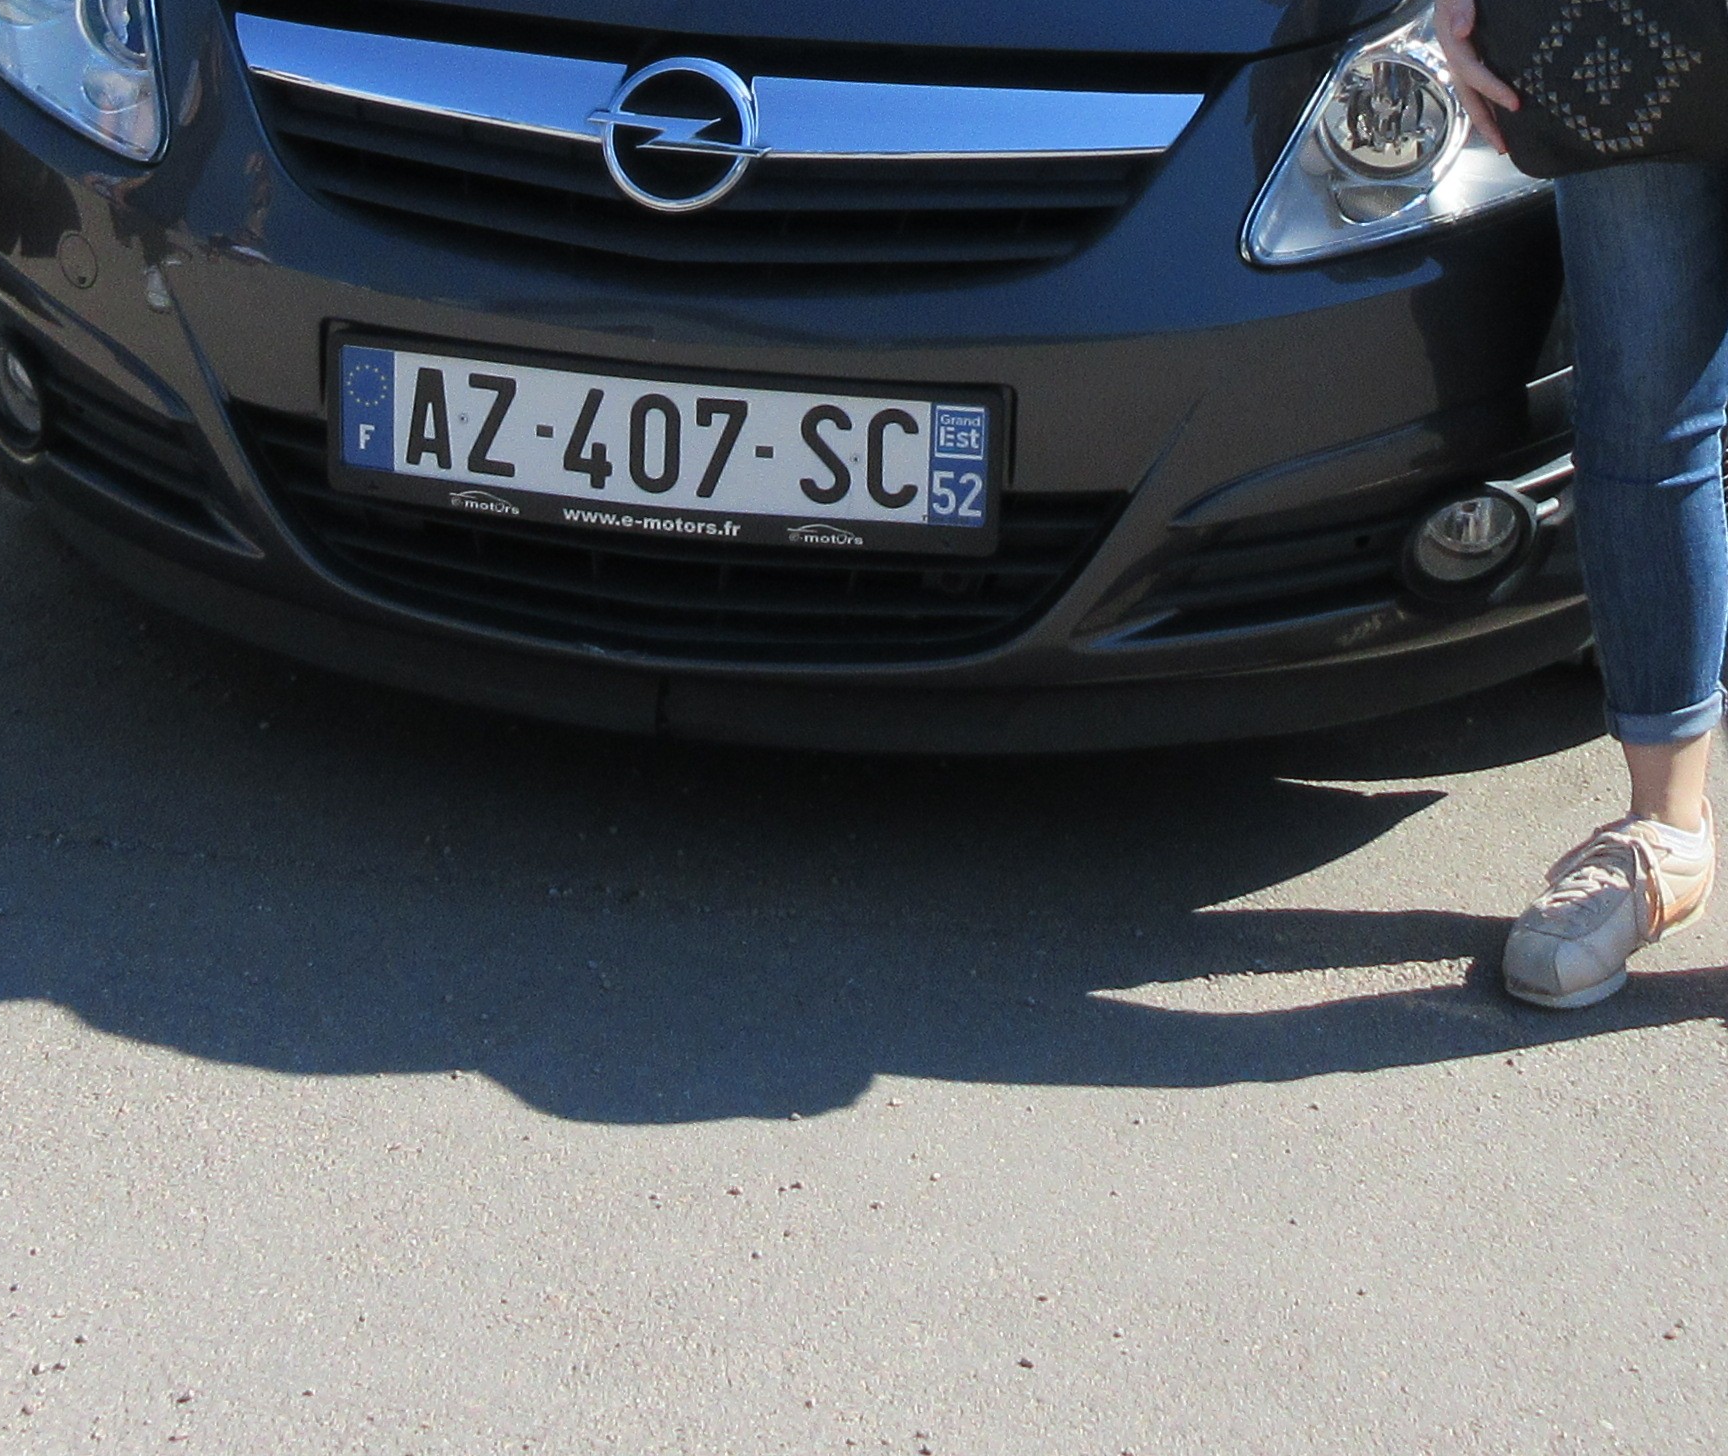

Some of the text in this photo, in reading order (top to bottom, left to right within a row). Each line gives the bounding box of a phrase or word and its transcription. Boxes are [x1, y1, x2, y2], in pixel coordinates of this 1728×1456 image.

[939, 413, 981, 428] Grand
[358, 424, 375, 450] F
[405, 367, 919, 509] AZ-407-SC
[938, 426, 980, 450] Est
[931, 470, 984, 518] 52
[563, 508, 741, 537] www.e-motors.fr
